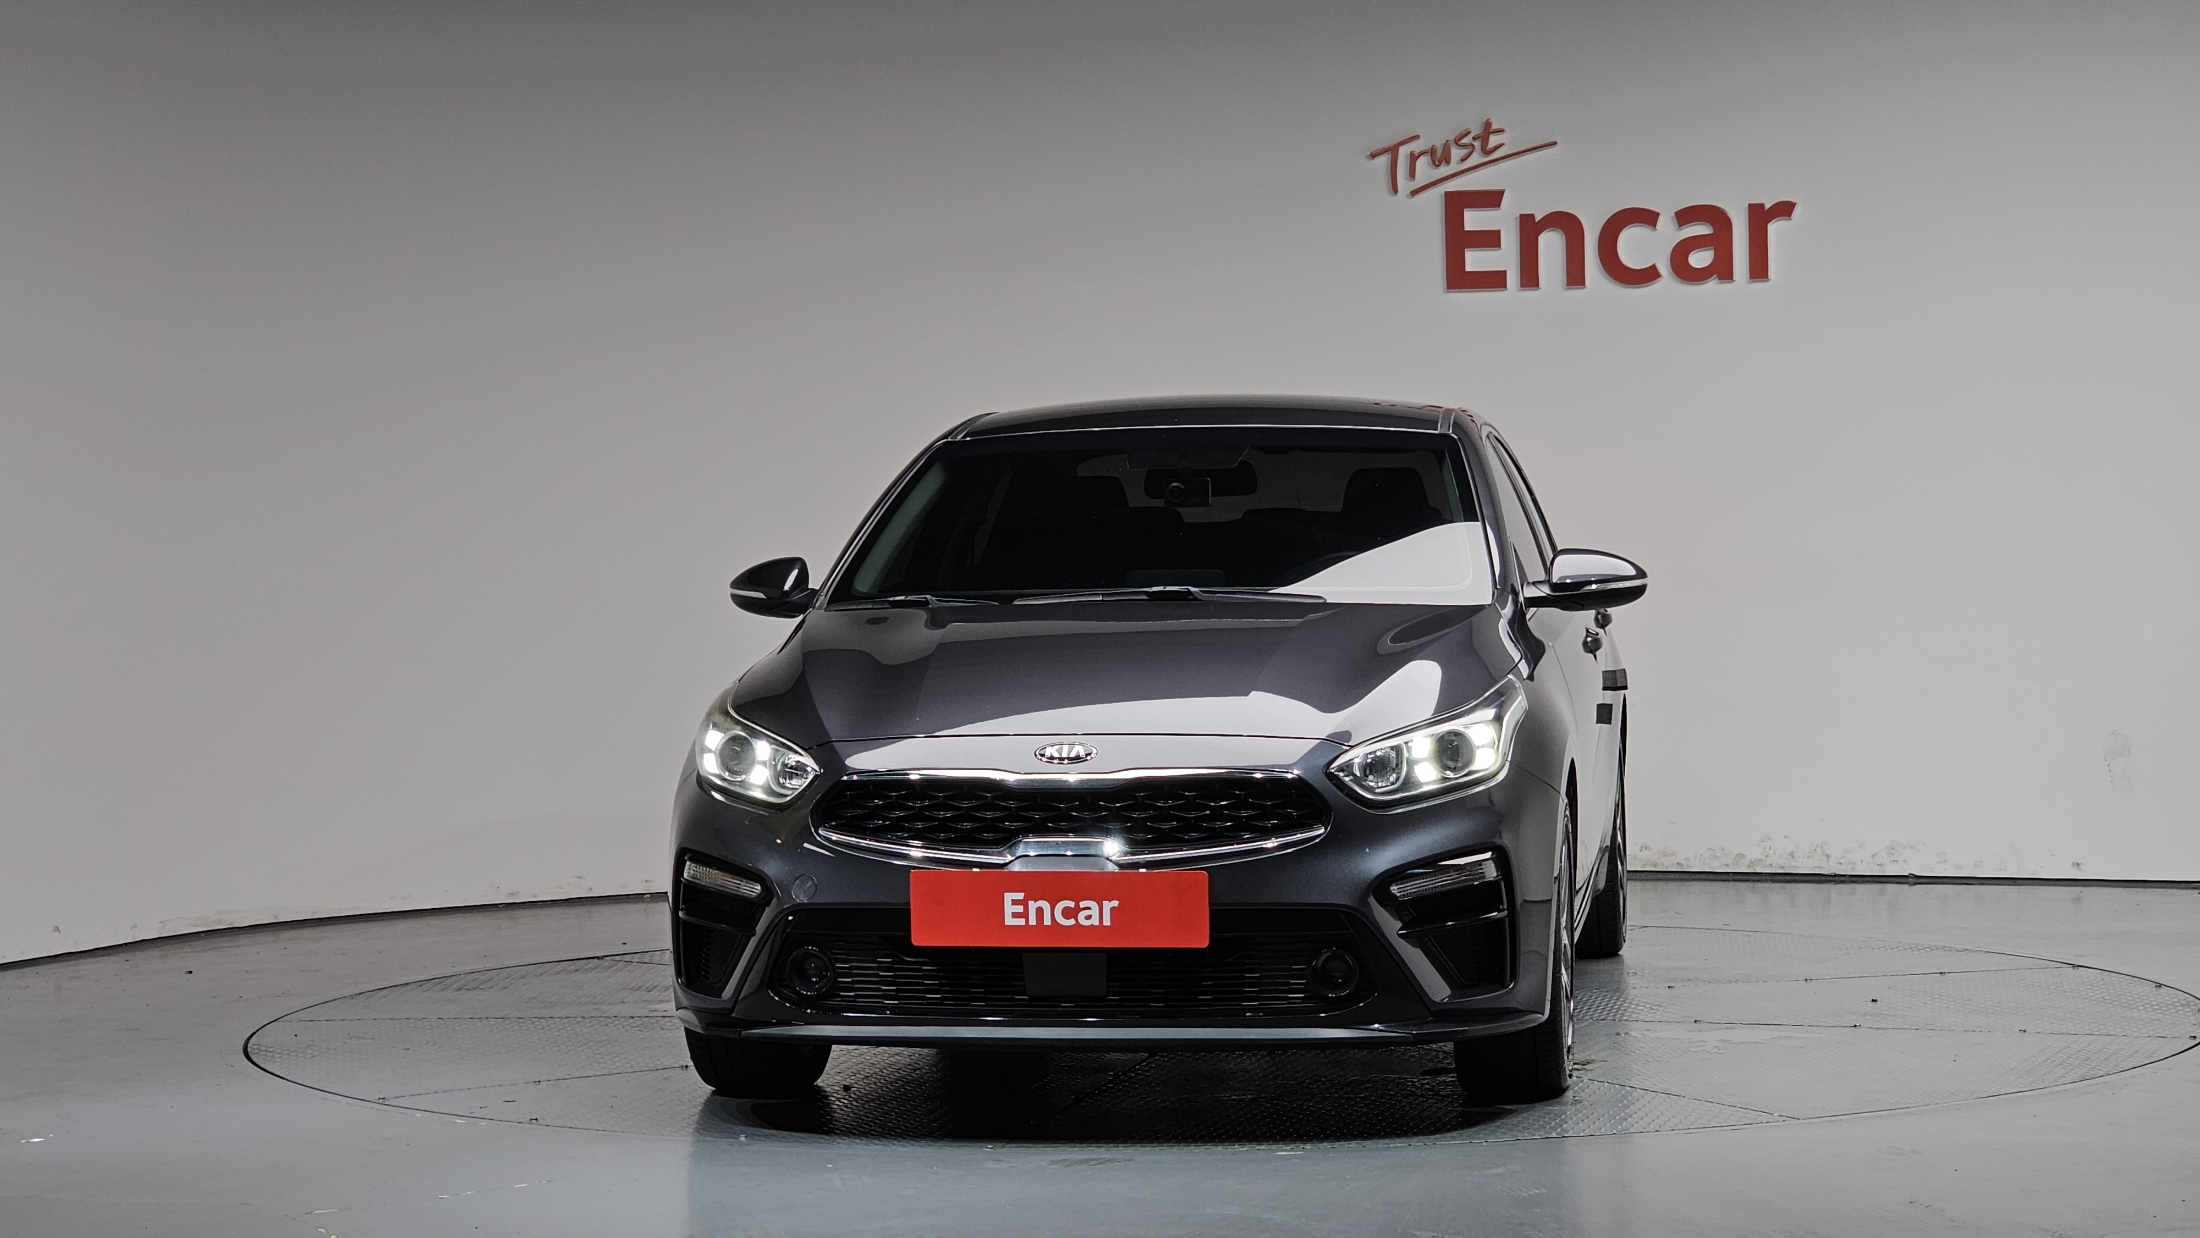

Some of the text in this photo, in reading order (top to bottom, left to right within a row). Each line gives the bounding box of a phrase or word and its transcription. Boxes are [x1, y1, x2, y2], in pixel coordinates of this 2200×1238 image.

[1369, 118, 1506, 195] Trust
[1443, 189, 1798, 292] Encar
[1044, 744, 1087, 758] KIA
[1003, 892, 1120, 927] Encar
